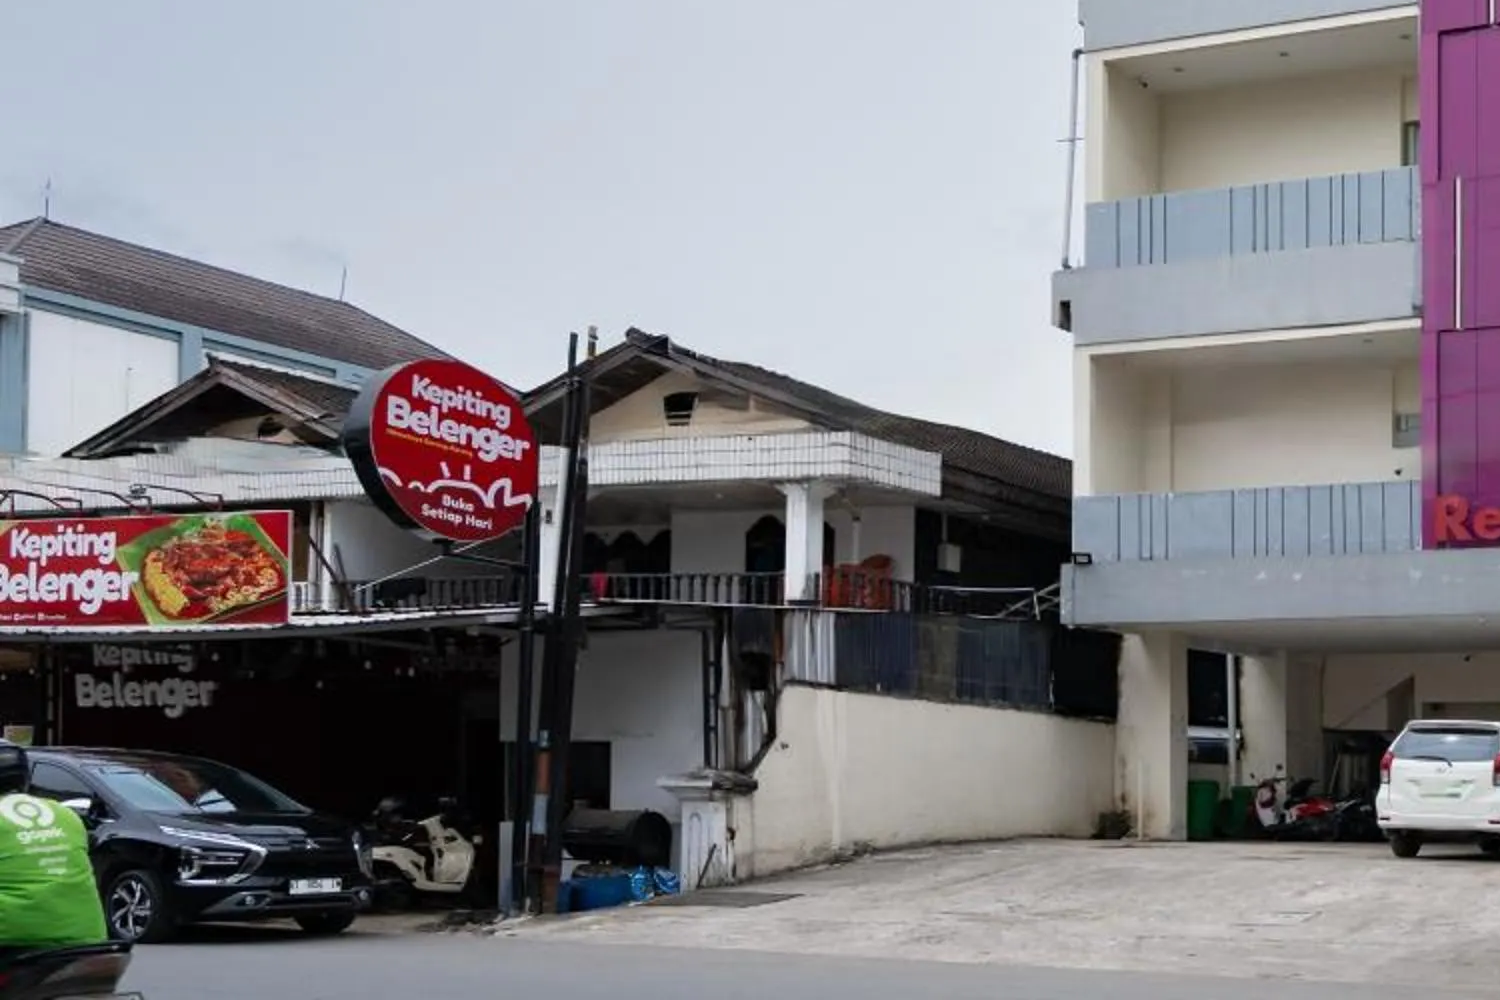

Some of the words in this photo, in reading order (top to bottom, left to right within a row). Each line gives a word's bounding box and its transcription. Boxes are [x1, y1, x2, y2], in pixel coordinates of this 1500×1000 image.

[412, 373, 511, 430] Kepiting
[387, 395, 530, 462] Belenger
[421, 503, 463, 524] Setiap
[466, 514, 493, 529] Hari
[442, 494, 474, 512] Buka
[10, 523, 117, 567] Kepiting
[75, 671, 219, 718] Belenger
